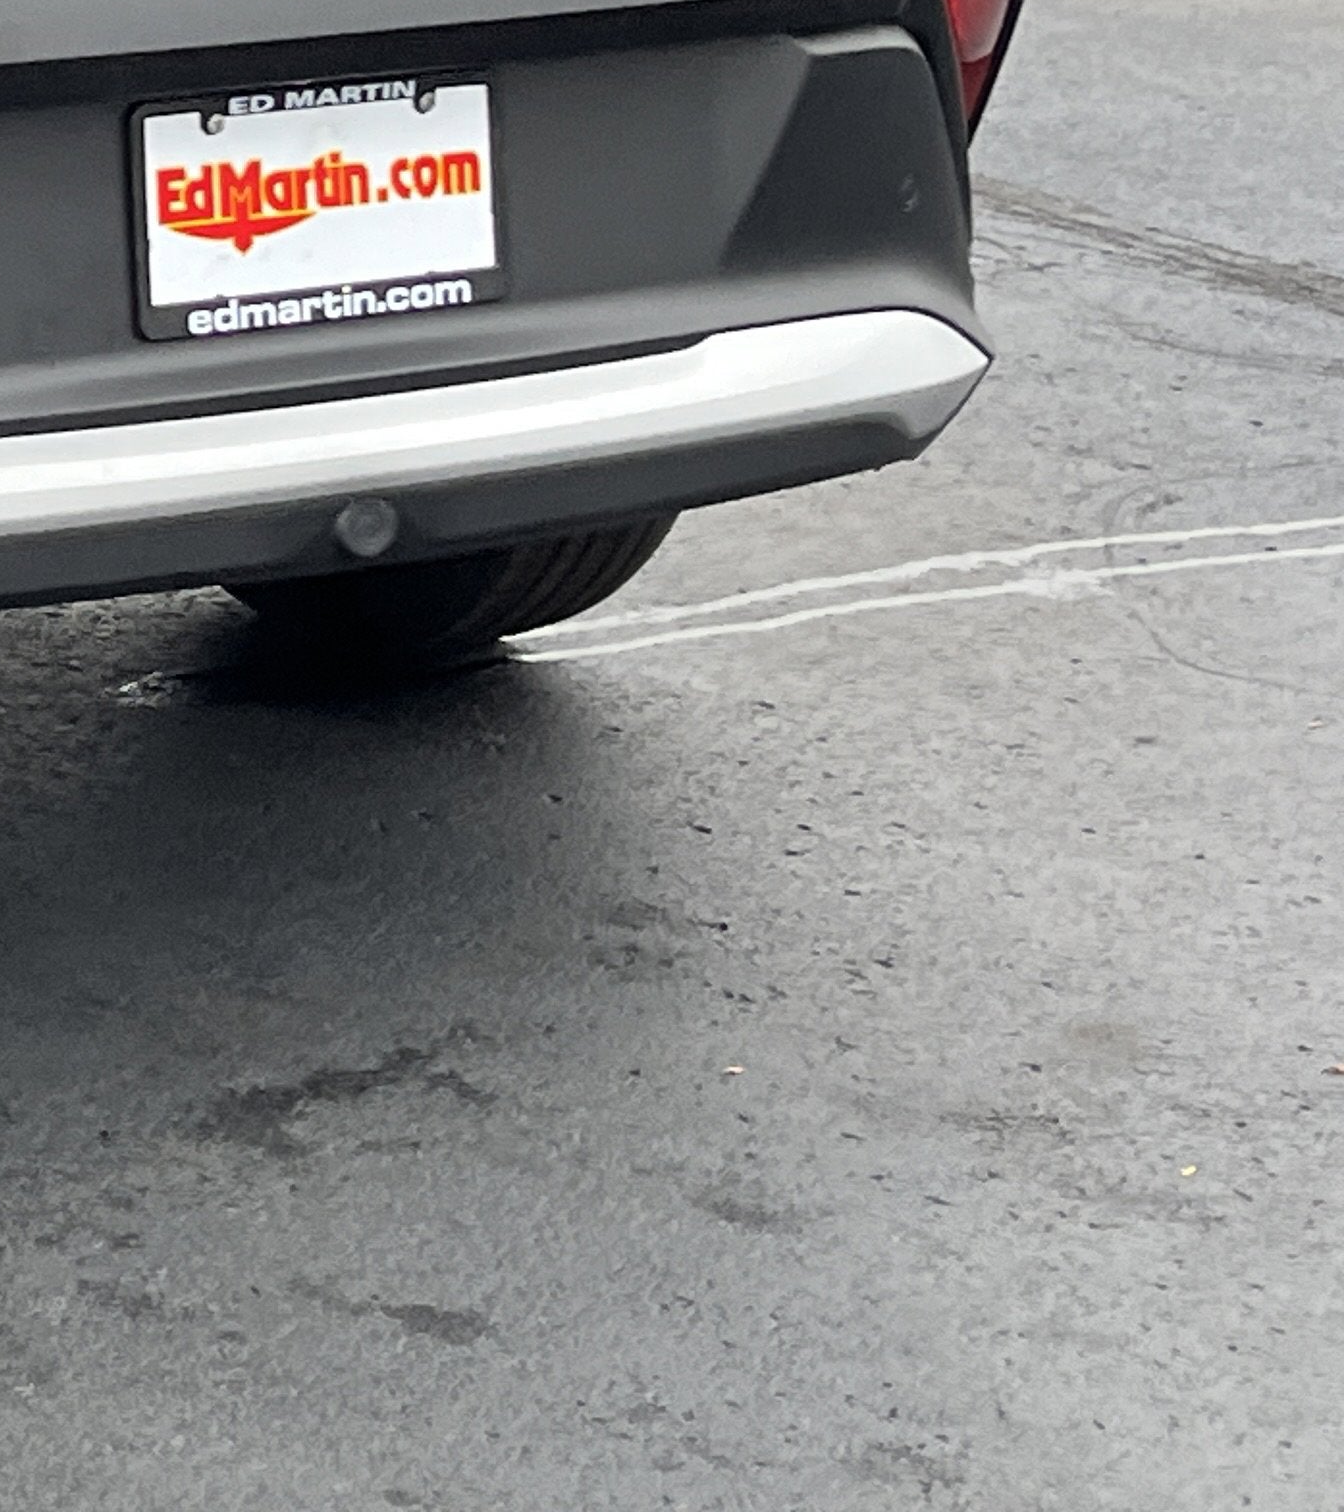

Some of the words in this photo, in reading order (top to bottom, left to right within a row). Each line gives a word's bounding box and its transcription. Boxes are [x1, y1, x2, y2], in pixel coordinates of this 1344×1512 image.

[228, 95, 275, 115] ED
[284, 80, 416, 110] MARTIN
[156, 151, 481, 225] EdMartin.com
[187, 278, 473, 335] edmartin.com
